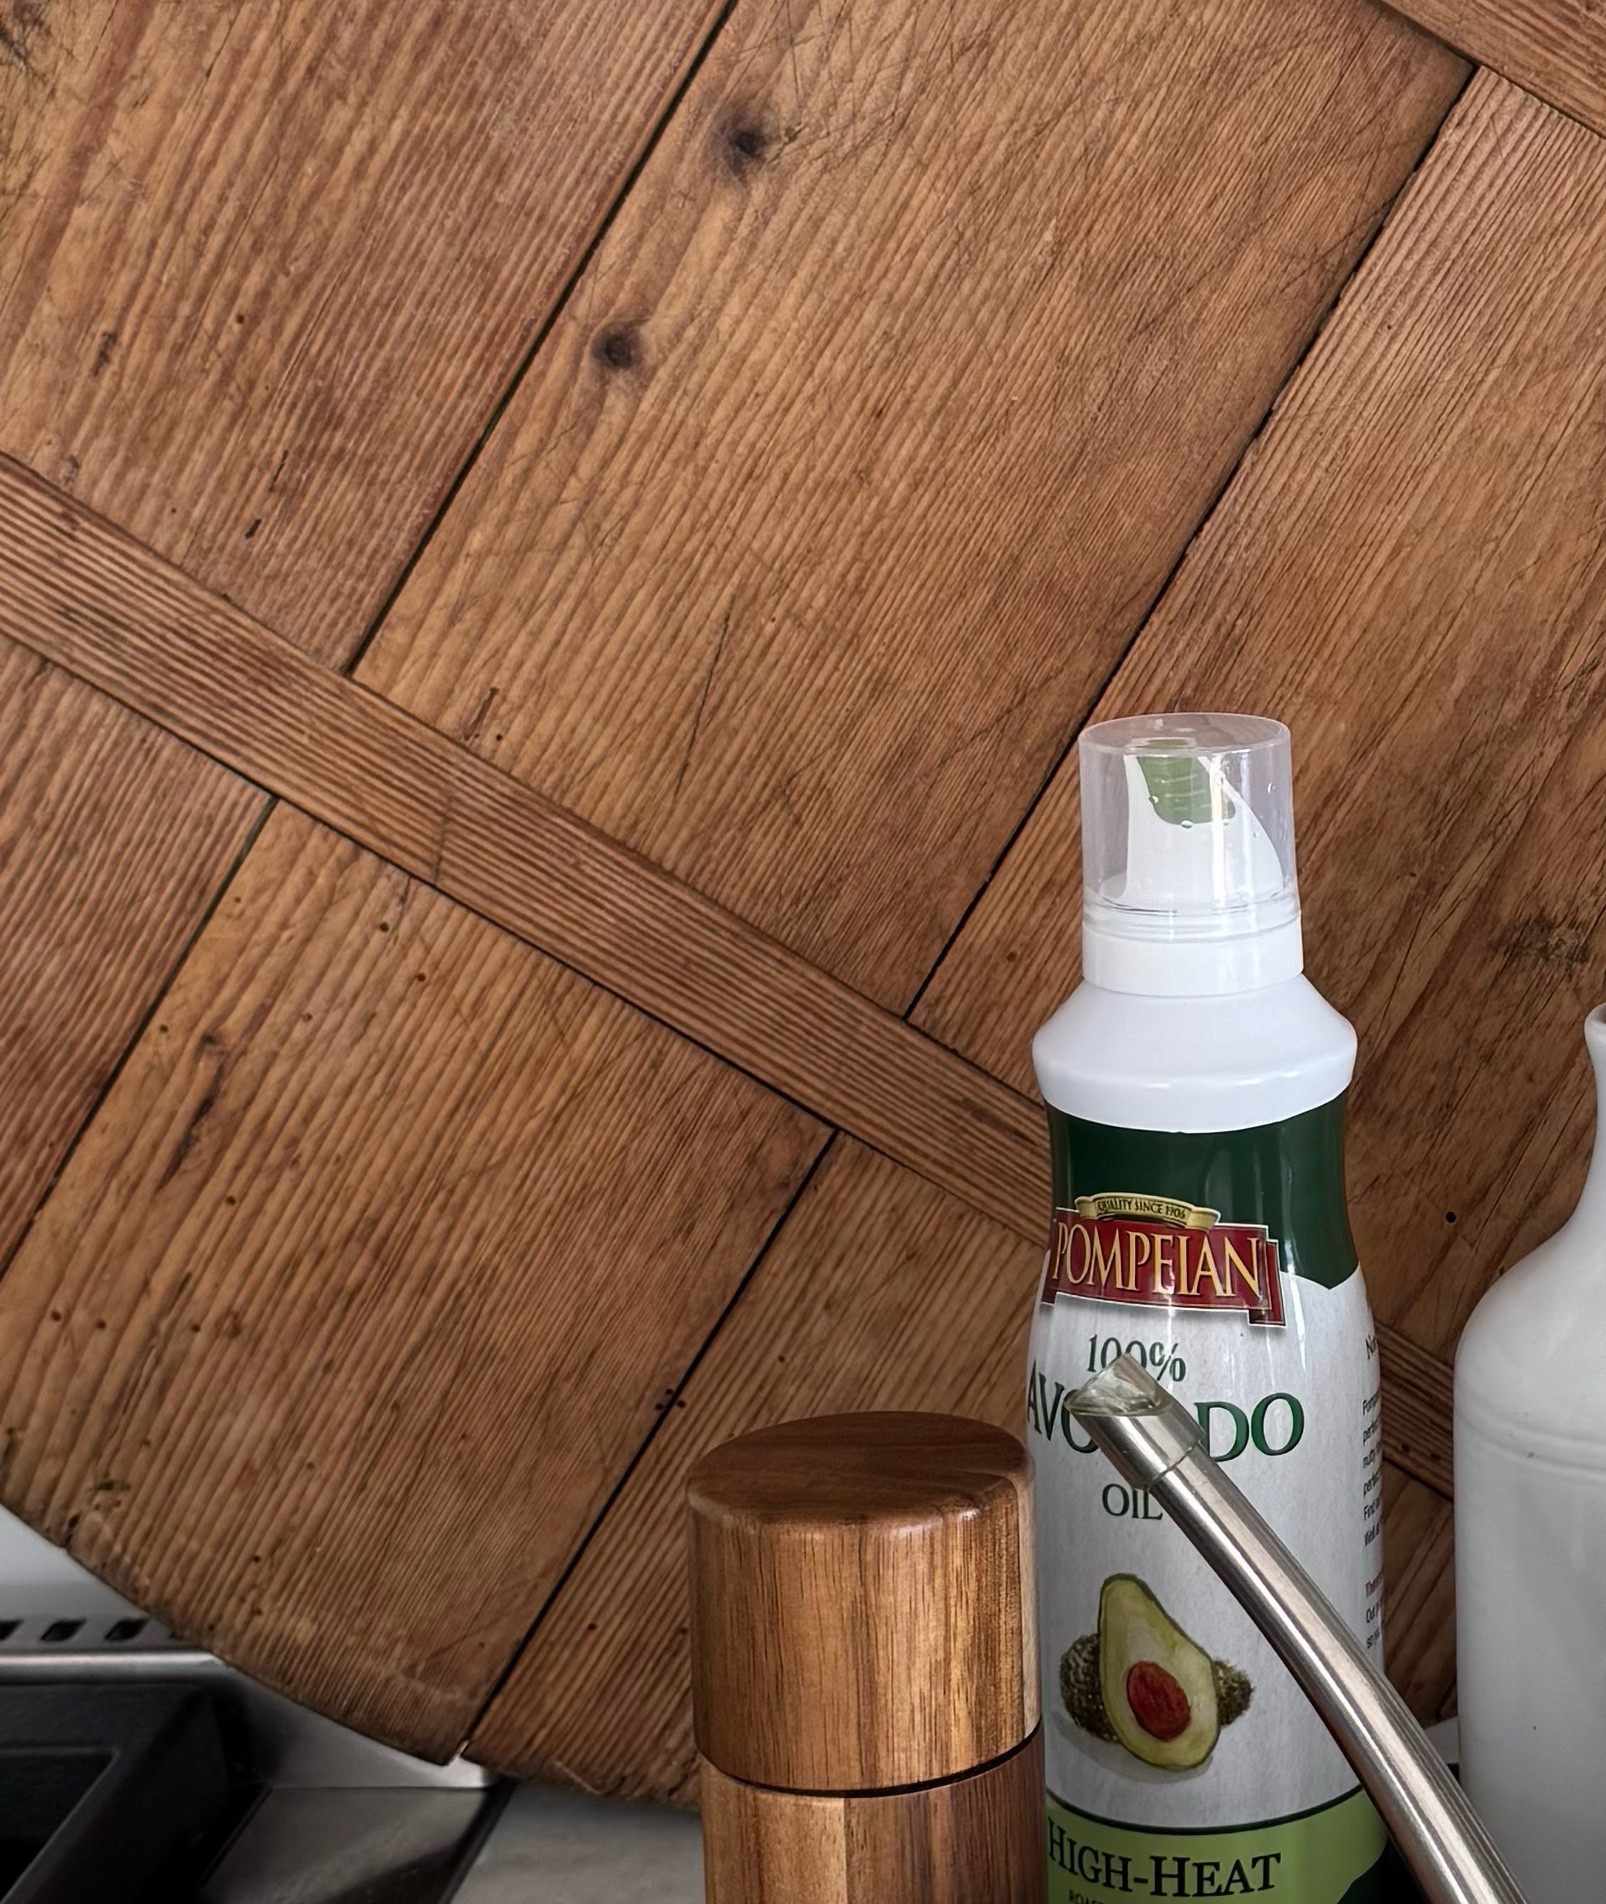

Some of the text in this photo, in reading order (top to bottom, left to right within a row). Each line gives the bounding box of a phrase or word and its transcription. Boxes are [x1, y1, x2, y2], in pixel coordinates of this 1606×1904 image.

[1097, 1197, 1132, 1213] QUALITY
[1134, 1200, 1163, 1215] SINCE
[1052, 1221, 1263, 1300] POMPEIAN
[1027, 1360, 1305, 1463] AVODO
[1101, 1483, 1164, 1521] OIL
[1047, 1816, 1282, 1898] HIGH-HEAT
